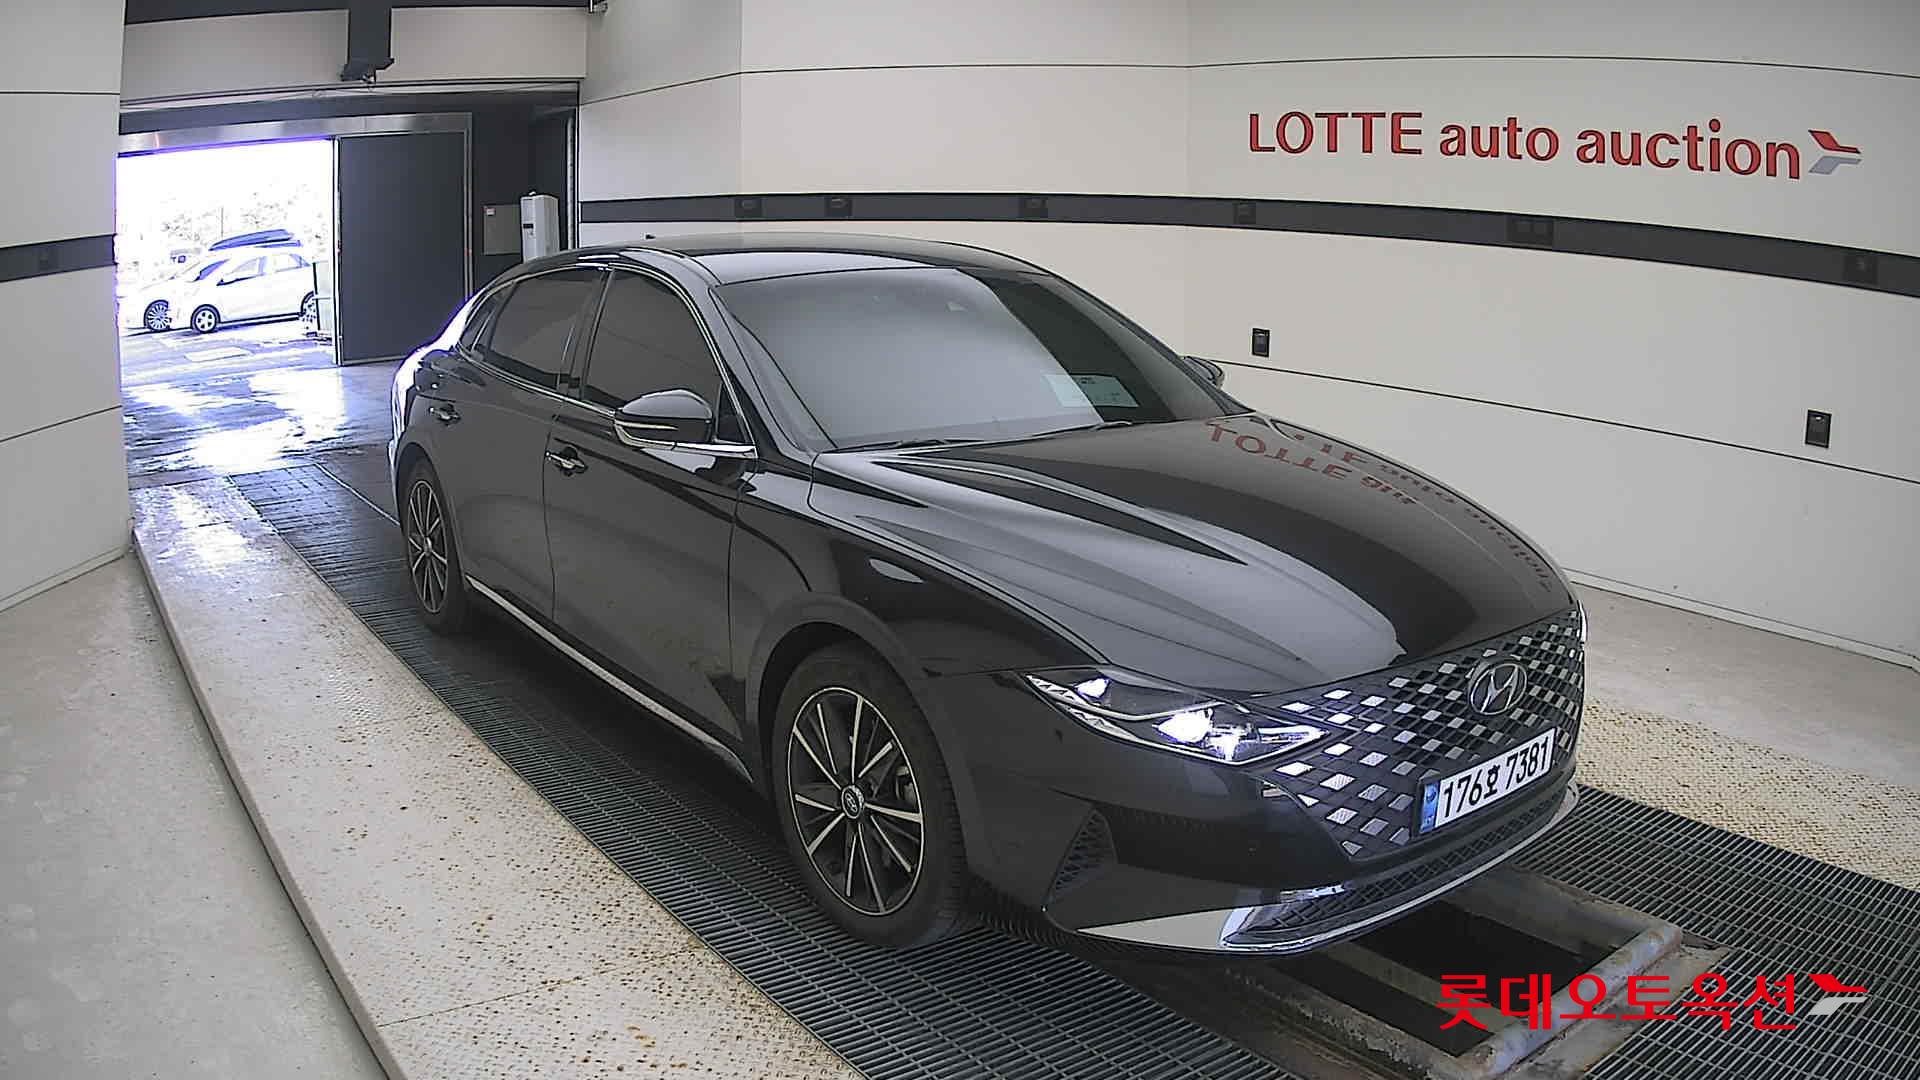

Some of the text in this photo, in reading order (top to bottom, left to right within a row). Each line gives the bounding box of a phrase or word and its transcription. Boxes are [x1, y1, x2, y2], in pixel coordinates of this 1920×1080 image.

[1249, 111, 1801, 180] LOTTE auto auction
[1444, 736, 1549, 818] 176호 7381
